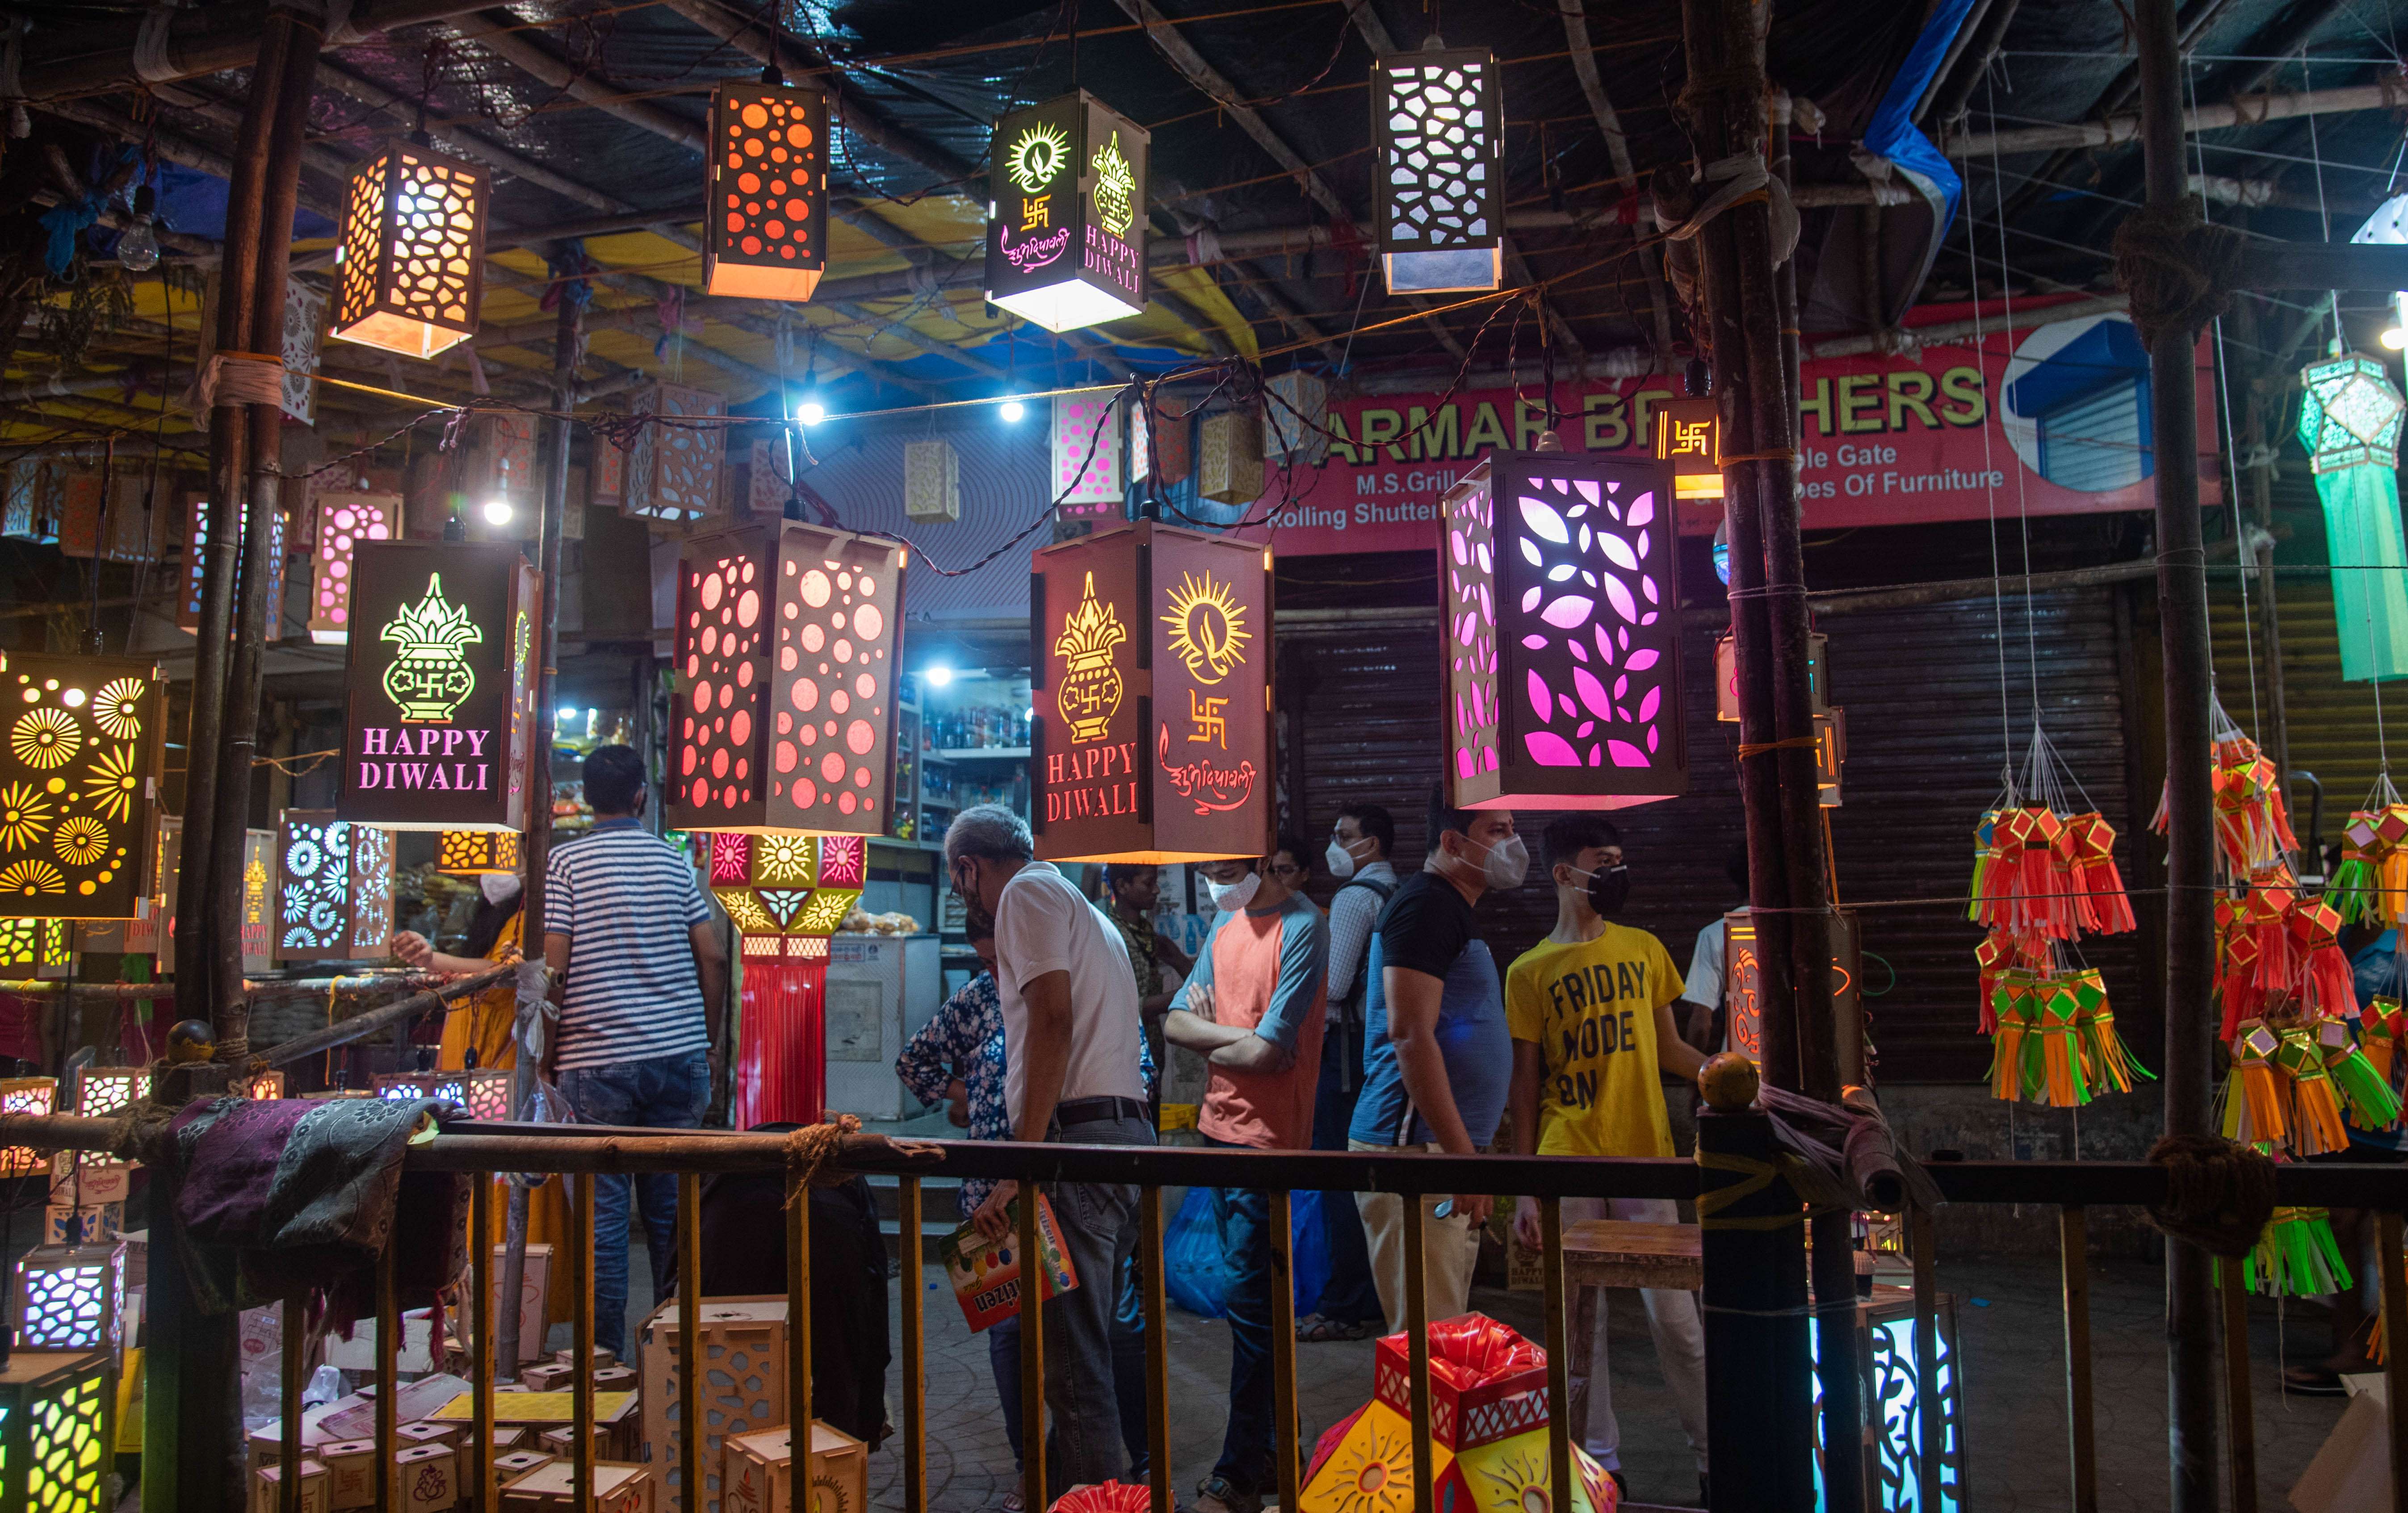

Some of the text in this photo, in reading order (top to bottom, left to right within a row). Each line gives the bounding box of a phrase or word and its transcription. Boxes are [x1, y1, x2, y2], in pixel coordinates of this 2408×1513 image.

[1086, 224, 1140, 268] HAPPY
[1084, 247, 1140, 293] DIWALI
[1837, 444, 1897, 467] Gate
[1266, 504, 1347, 530] Rolling
[1844, 473, 1875, 497] Of
[1883, 468, 2004, 494] Furniture
[362, 728, 490, 757] HAPPY
[1048, 742, 1137, 784] HAPPY
[358, 762, 489, 791] DIWALI
[1047, 782, 1137, 822] DIWALI
[1548, 961, 1645, 1020] FRIDAY
